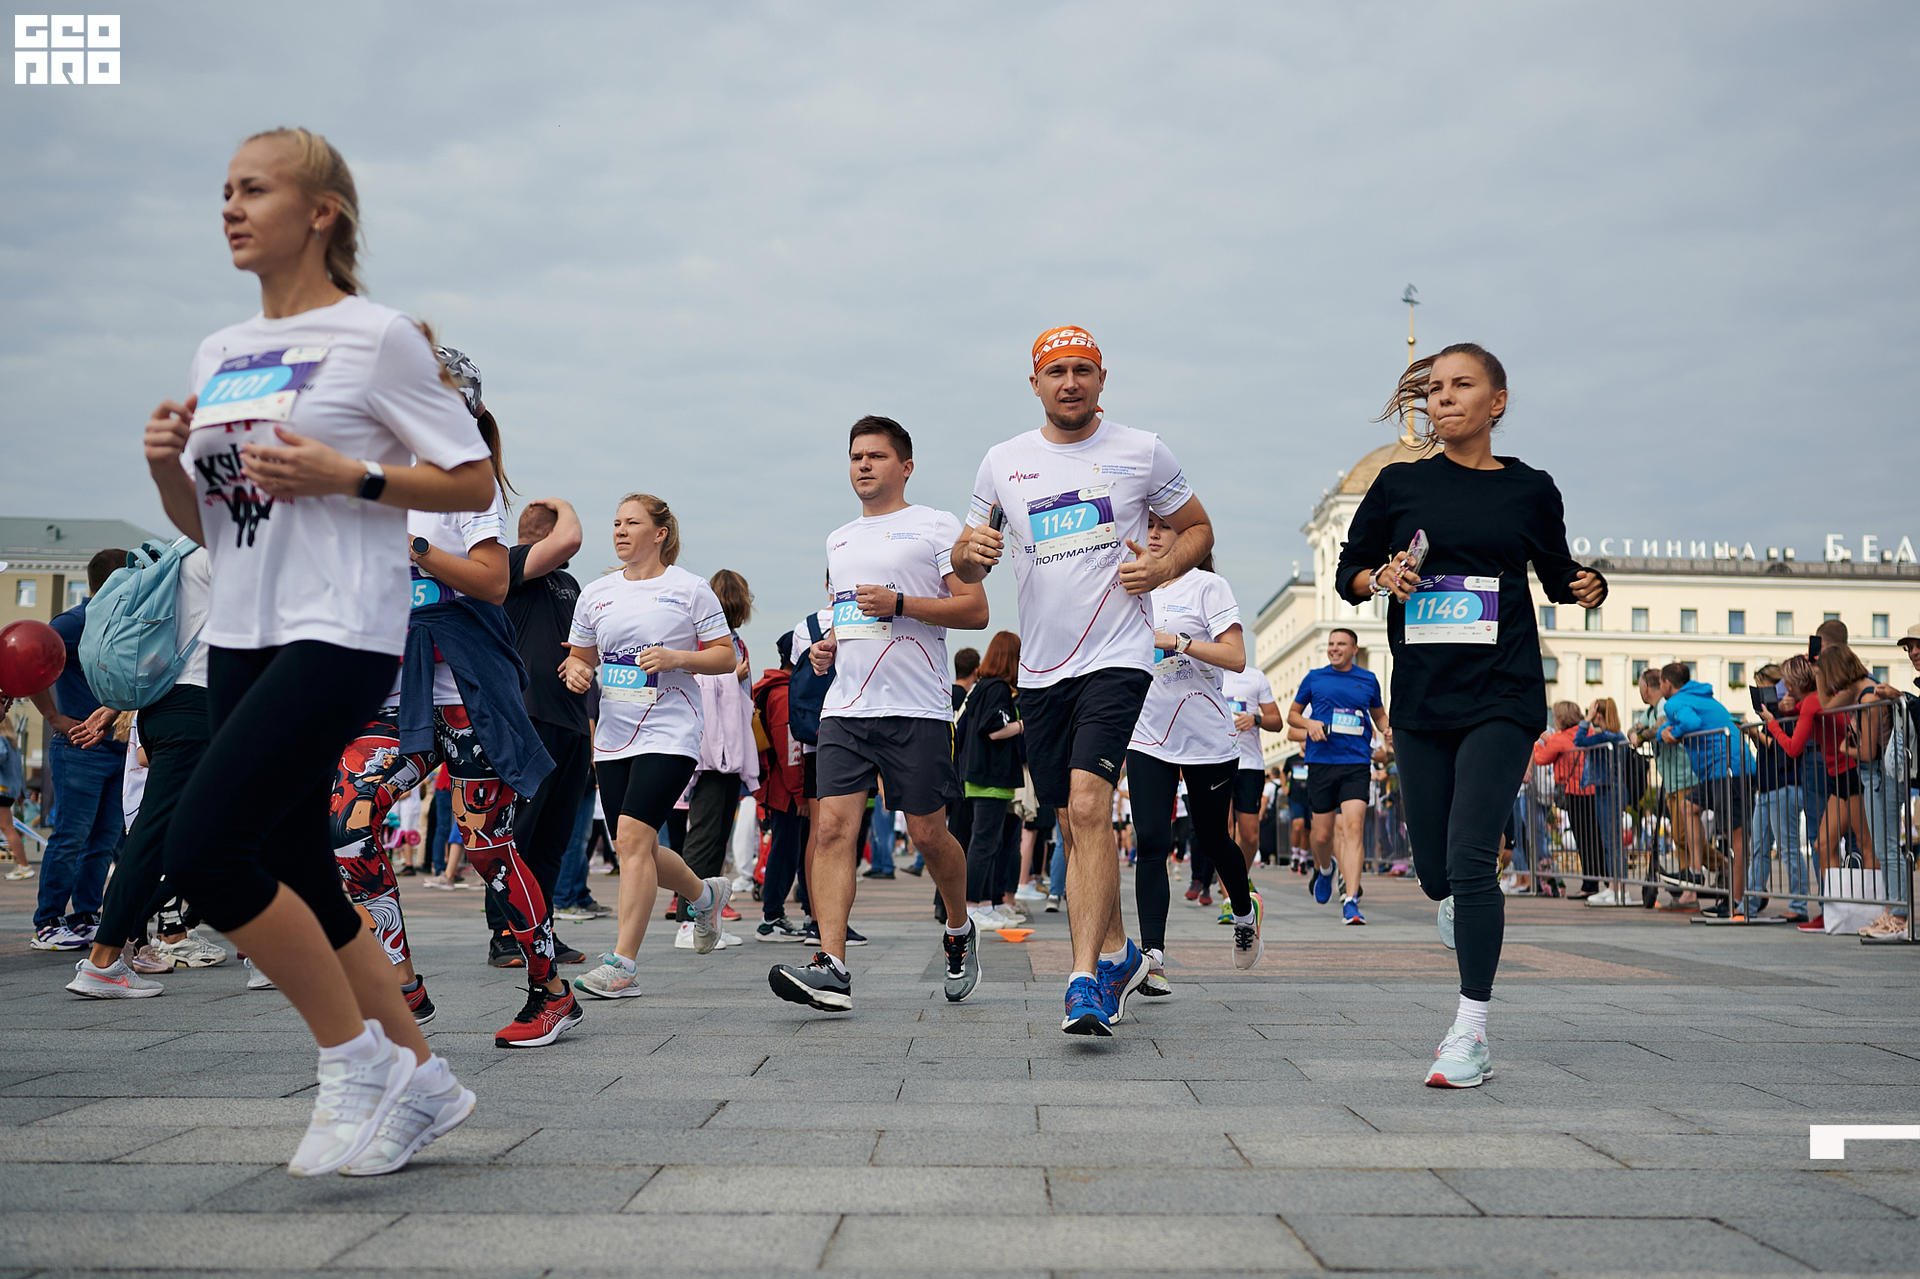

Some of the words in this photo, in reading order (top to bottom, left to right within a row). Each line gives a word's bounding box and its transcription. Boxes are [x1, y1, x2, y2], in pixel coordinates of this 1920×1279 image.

[208, 371, 275, 403] 1101
[1042, 507, 1087, 536] 1147
[1572, 536, 1756, 560] ОСТИНИЦА
[1416, 597, 1469, 620] 1146
[607, 667, 638, 686] 1159
[1163, 668, 1194, 686] 2021
[1336, 714, 1357, 726] 1331
